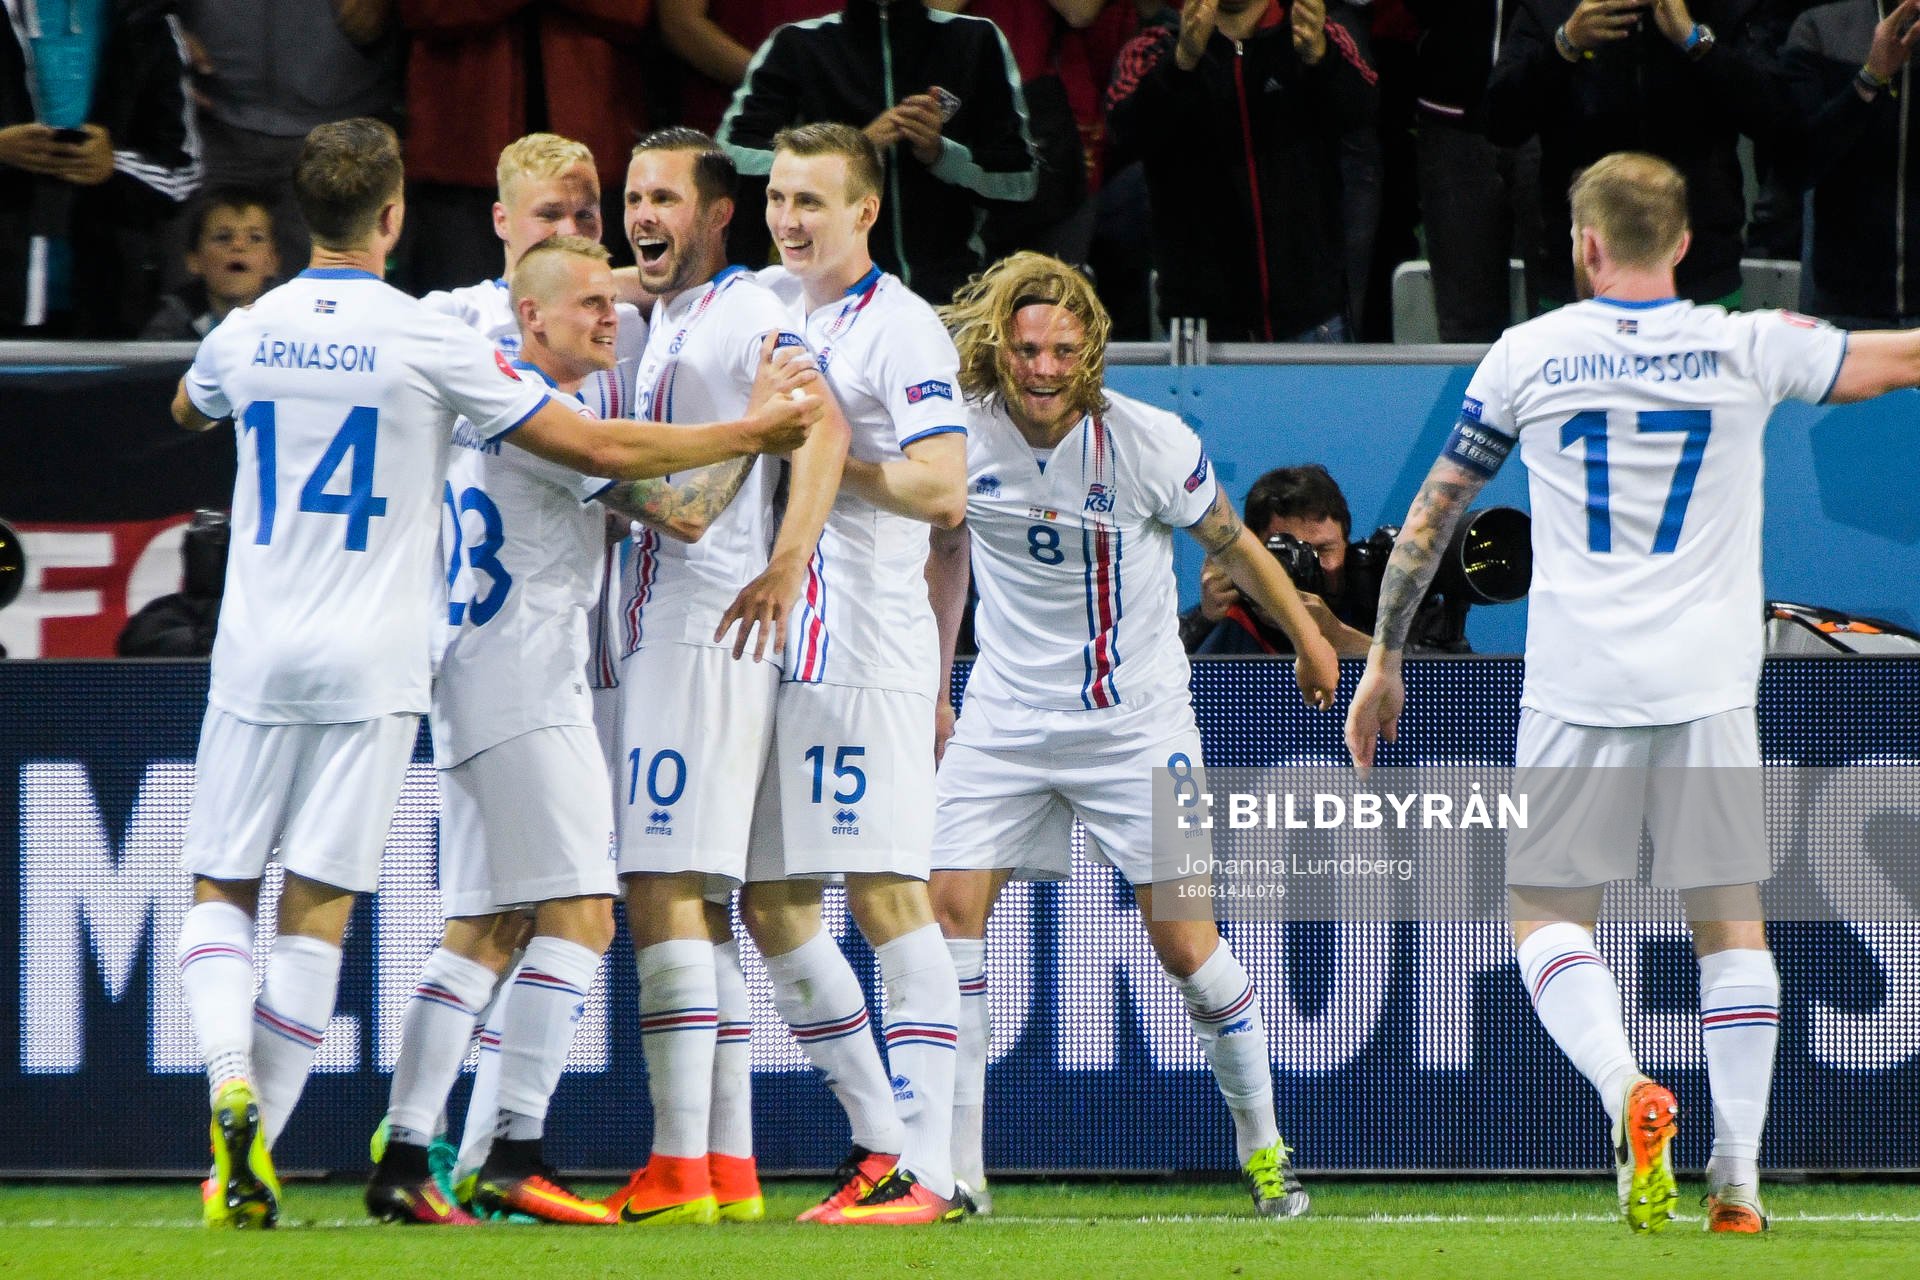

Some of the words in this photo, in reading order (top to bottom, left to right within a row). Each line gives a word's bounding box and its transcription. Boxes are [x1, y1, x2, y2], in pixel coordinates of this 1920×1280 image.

[250, 333, 376, 373] ÁRNASON
[1542, 350, 1719, 386] GUNNARSSON
[237, 401, 388, 552] 14
[1559, 410, 1712, 554] 17
[1027, 525, 1065, 565] 8
[628, 747, 687, 806] 10
[805, 745, 866, 804] 15
[1167, 752, 1199, 808] 8
